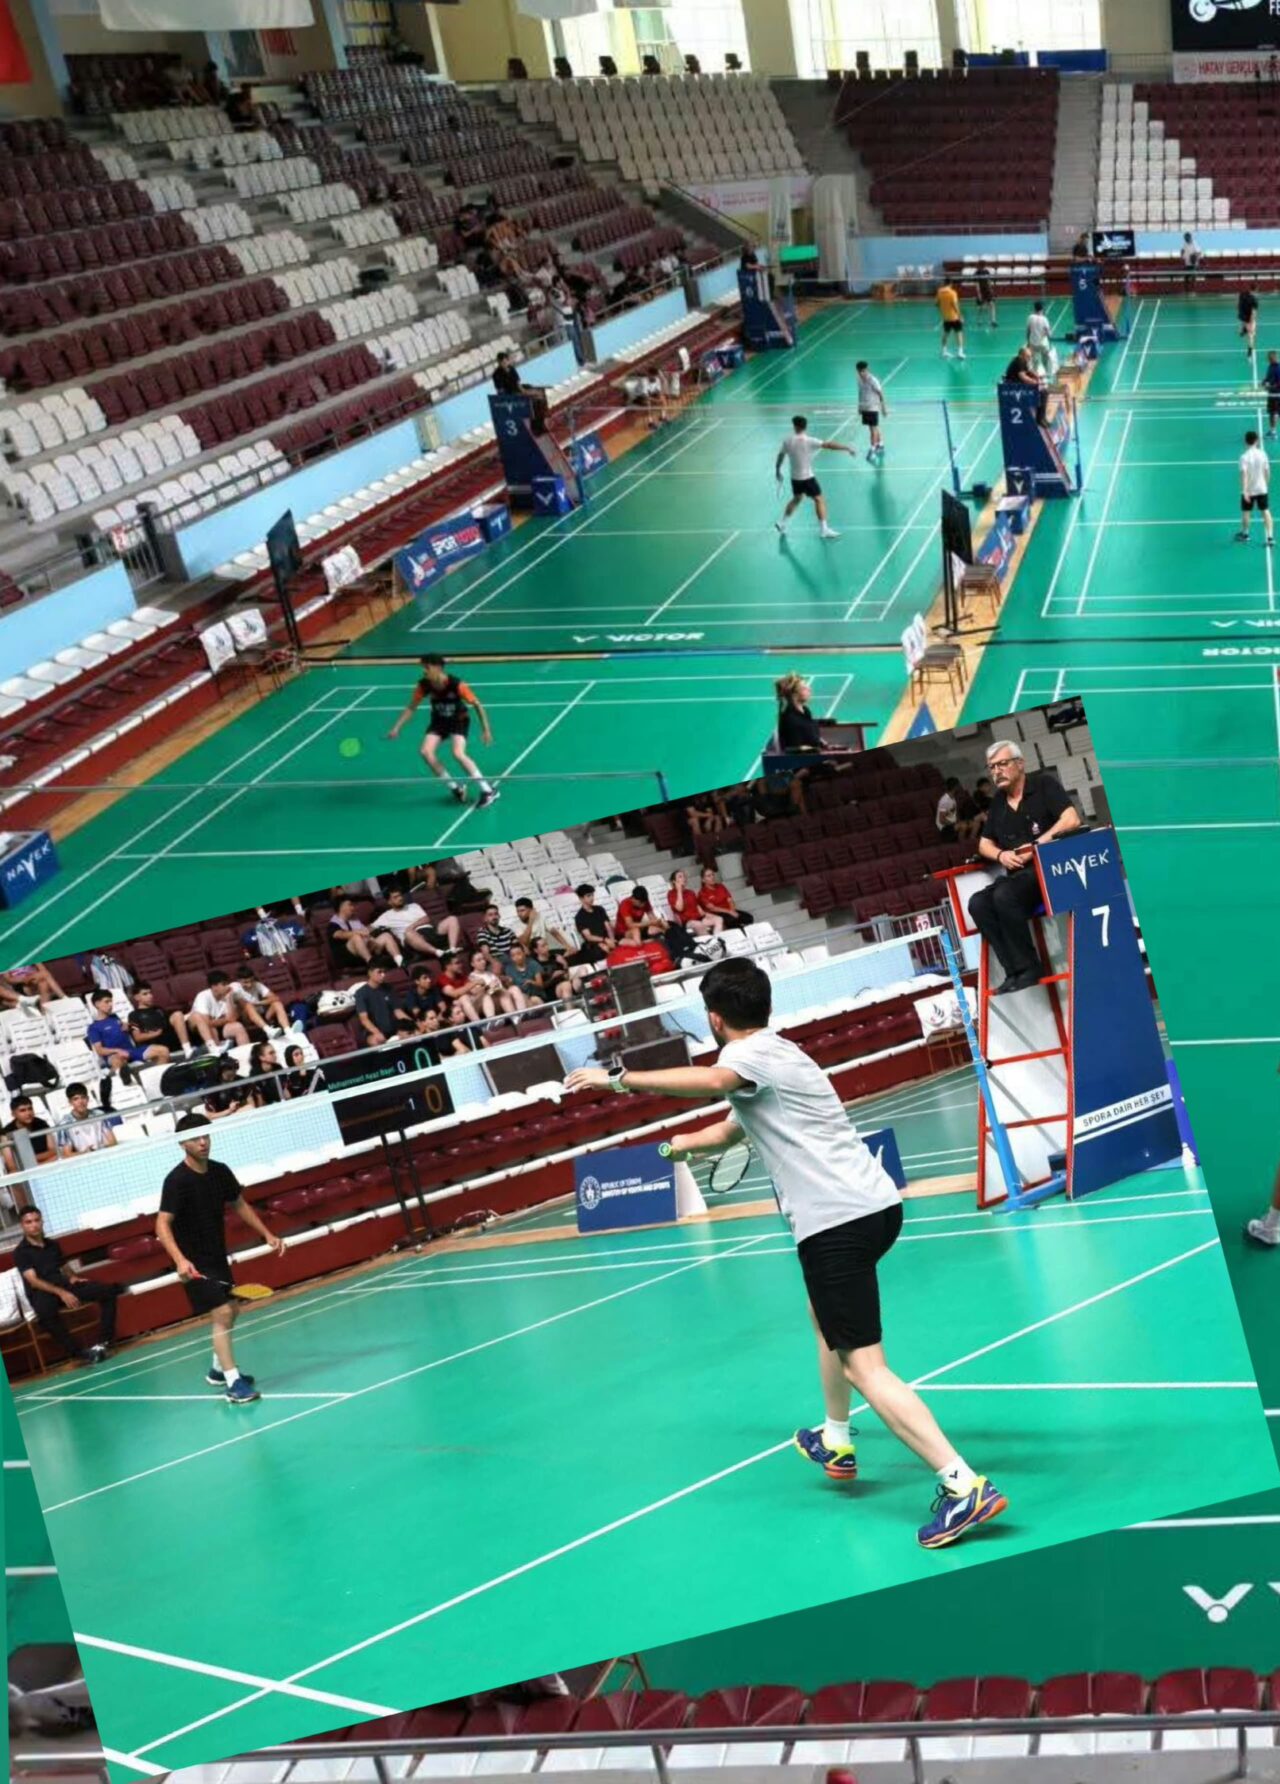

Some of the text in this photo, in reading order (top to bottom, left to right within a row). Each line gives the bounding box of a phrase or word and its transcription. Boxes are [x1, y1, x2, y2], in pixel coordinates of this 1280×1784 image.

[1010, 407, 1023, 424] 2
[505, 419, 518, 436] 3
[1051, 848, 1109, 890] NAVEK
[1091, 904, 1110, 948] 7
[396, 1060, 406, 1074] 0
[408, 1097, 416, 1111] 1
[424, 1084, 444, 1114] 0
[1083, 1111, 1113, 1127] SPORA
[1134, 1095, 1150, 1109] HER
